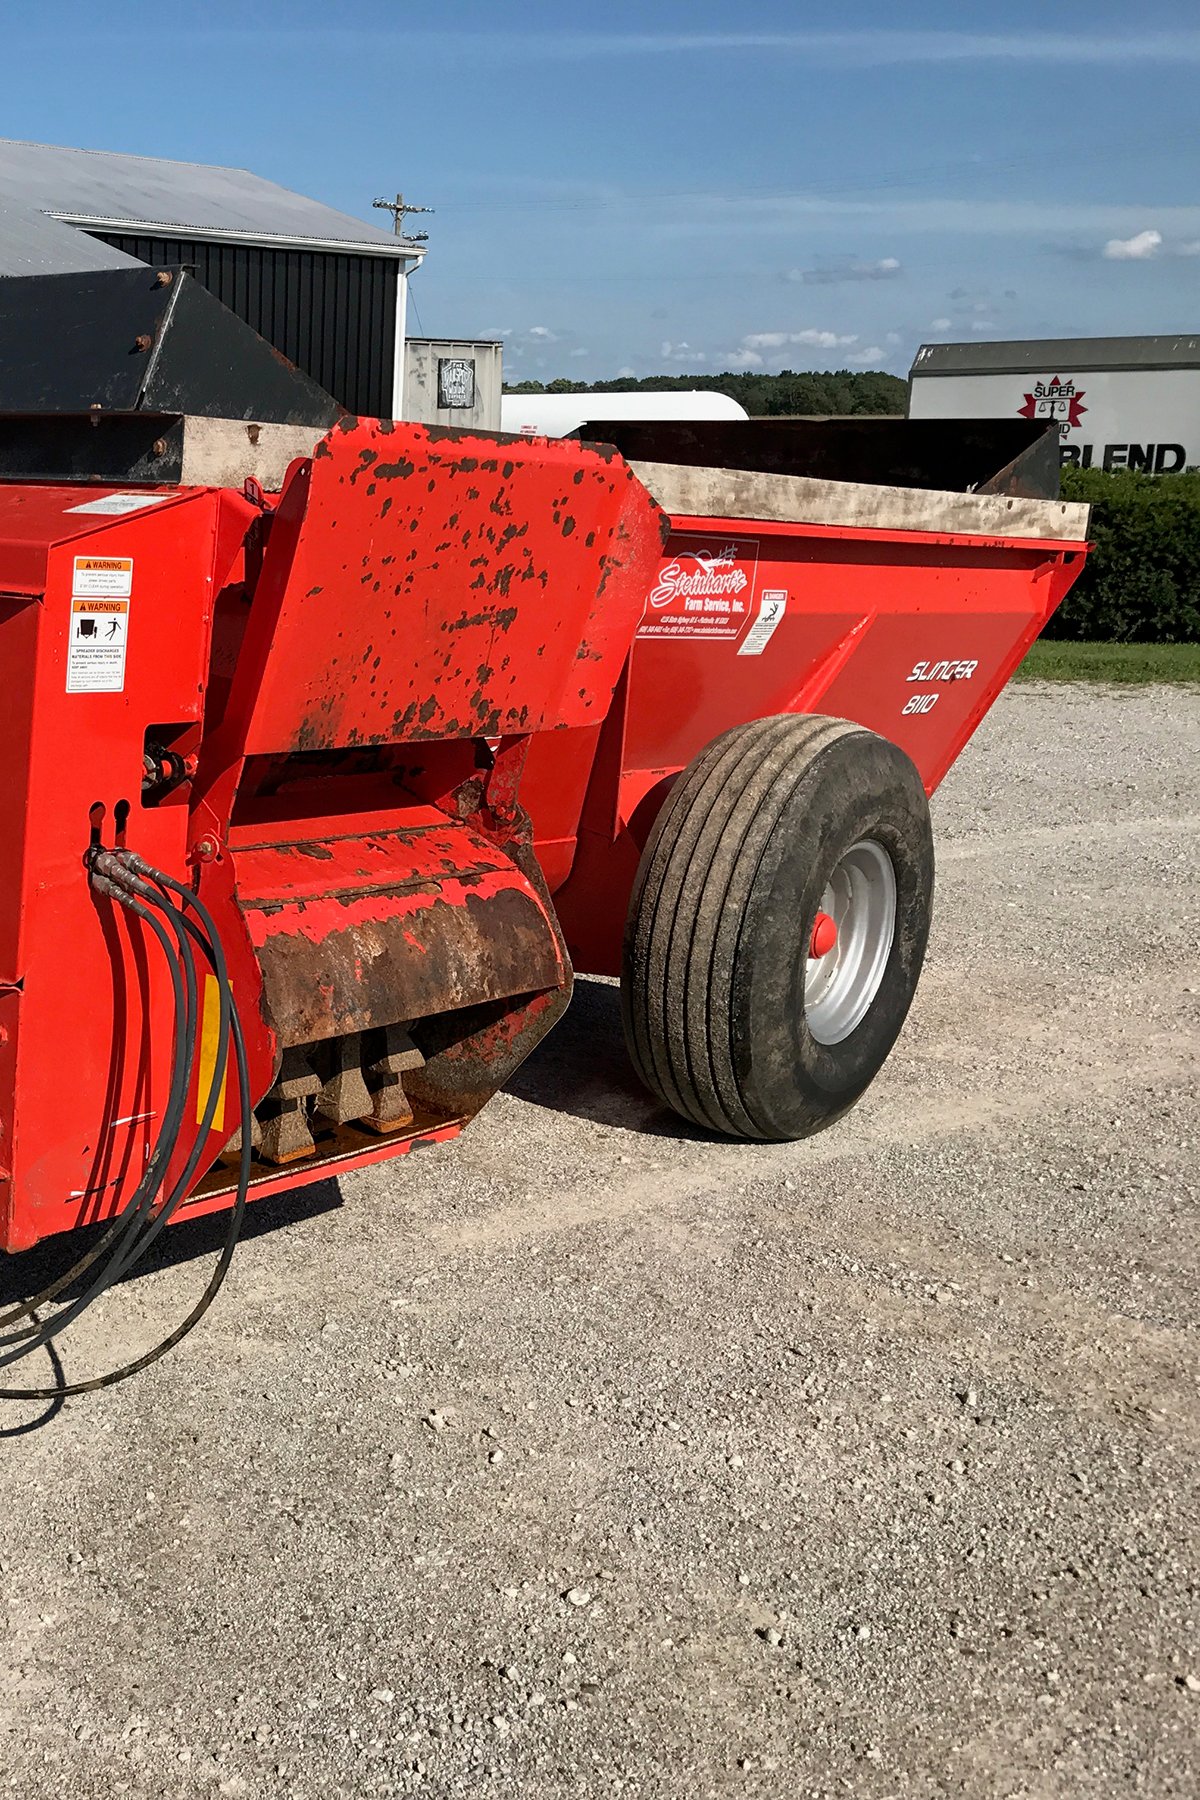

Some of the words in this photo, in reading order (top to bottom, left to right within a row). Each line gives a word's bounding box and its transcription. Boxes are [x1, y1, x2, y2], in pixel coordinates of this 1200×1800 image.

[1034, 386, 1075, 398] SUPER
[92, 561, 122, 570] WARNING
[650, 563, 748, 608] Steinhart's
[87, 602, 121, 612] WARNING
[685, 597, 704, 611] Farm
[731, 599, 745, 613] Inc.
[905, 660, 979, 682] SLINGER
[901, 693, 940, 715] 8110
